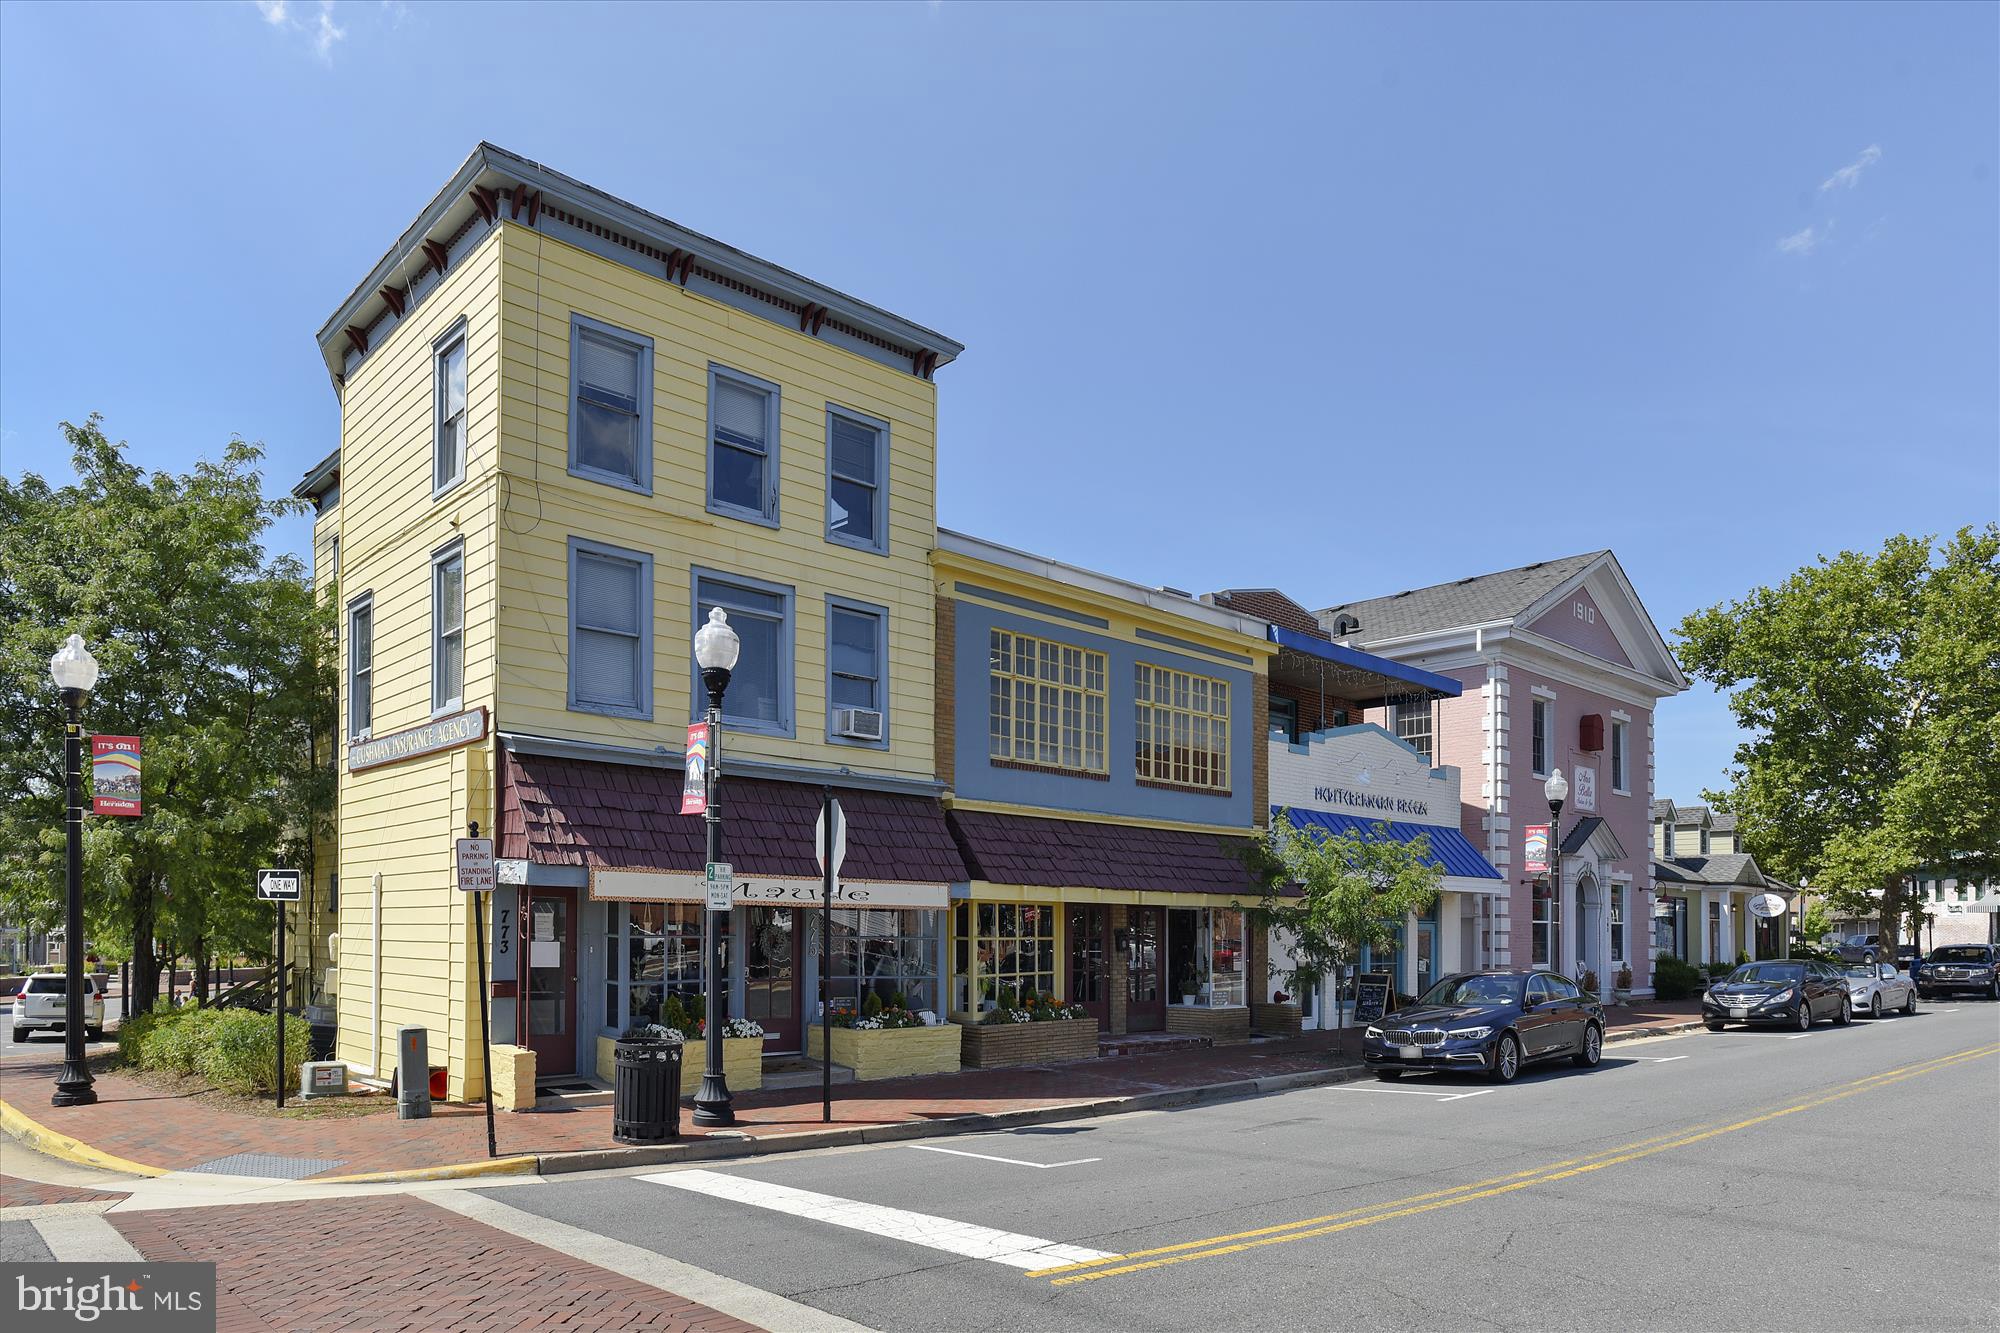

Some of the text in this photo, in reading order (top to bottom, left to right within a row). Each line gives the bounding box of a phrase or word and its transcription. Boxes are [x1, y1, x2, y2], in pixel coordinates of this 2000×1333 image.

[1573, 600, 1595, 624] 1910
[356, 717, 471, 764] CUSHMAN INSURANCE AGENCY
[99, 800, 135, 809] Herndon
[461, 852, 489, 860] PARKING
[460, 867, 492, 875] STANDING
[708, 866, 714, 879] 2
[270, 879, 296, 891] ONE WAY
[460, 876, 493, 886] FIRE LANE
[500, 909, 511, 954] 773
